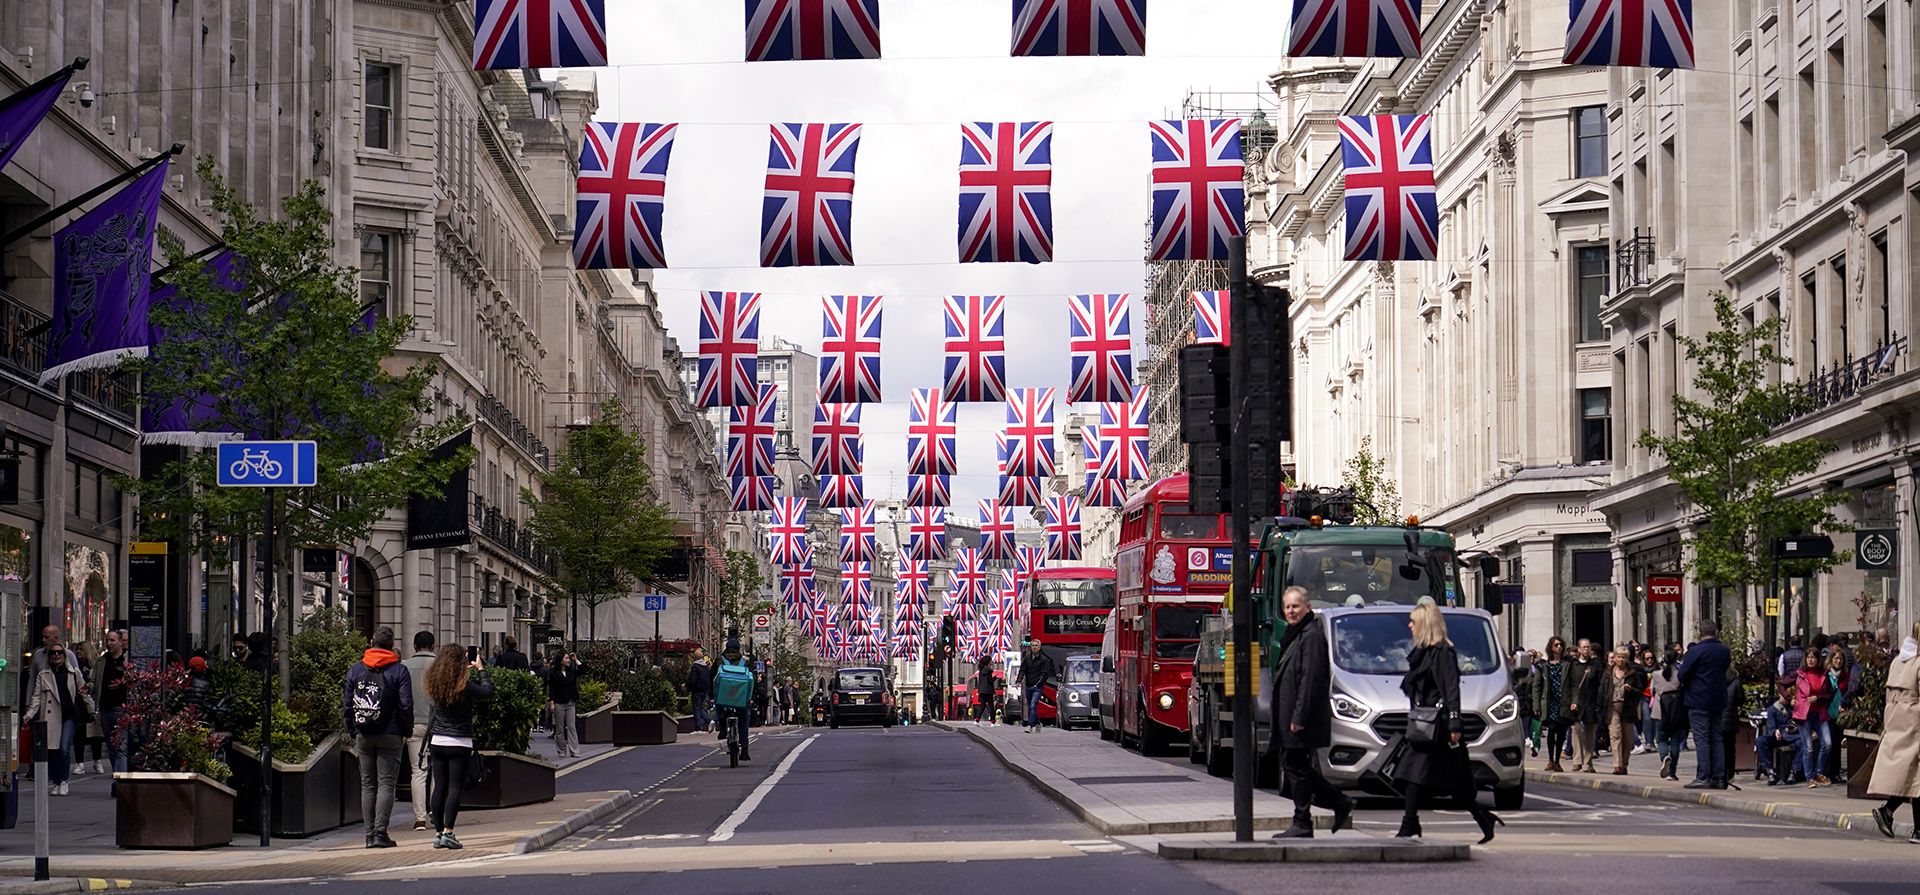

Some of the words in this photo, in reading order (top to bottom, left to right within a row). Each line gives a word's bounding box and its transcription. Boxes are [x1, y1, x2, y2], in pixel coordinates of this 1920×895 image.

[1556, 503, 1594, 516] Mappi
[435, 530, 465, 539] EXCHANGE
[1652, 585, 1679, 594] TUMI
[1768, 600, 1778, 613] H
[1048, 619, 1075, 627] Piccadilly
[1093, 616, 1108, 627] 94
